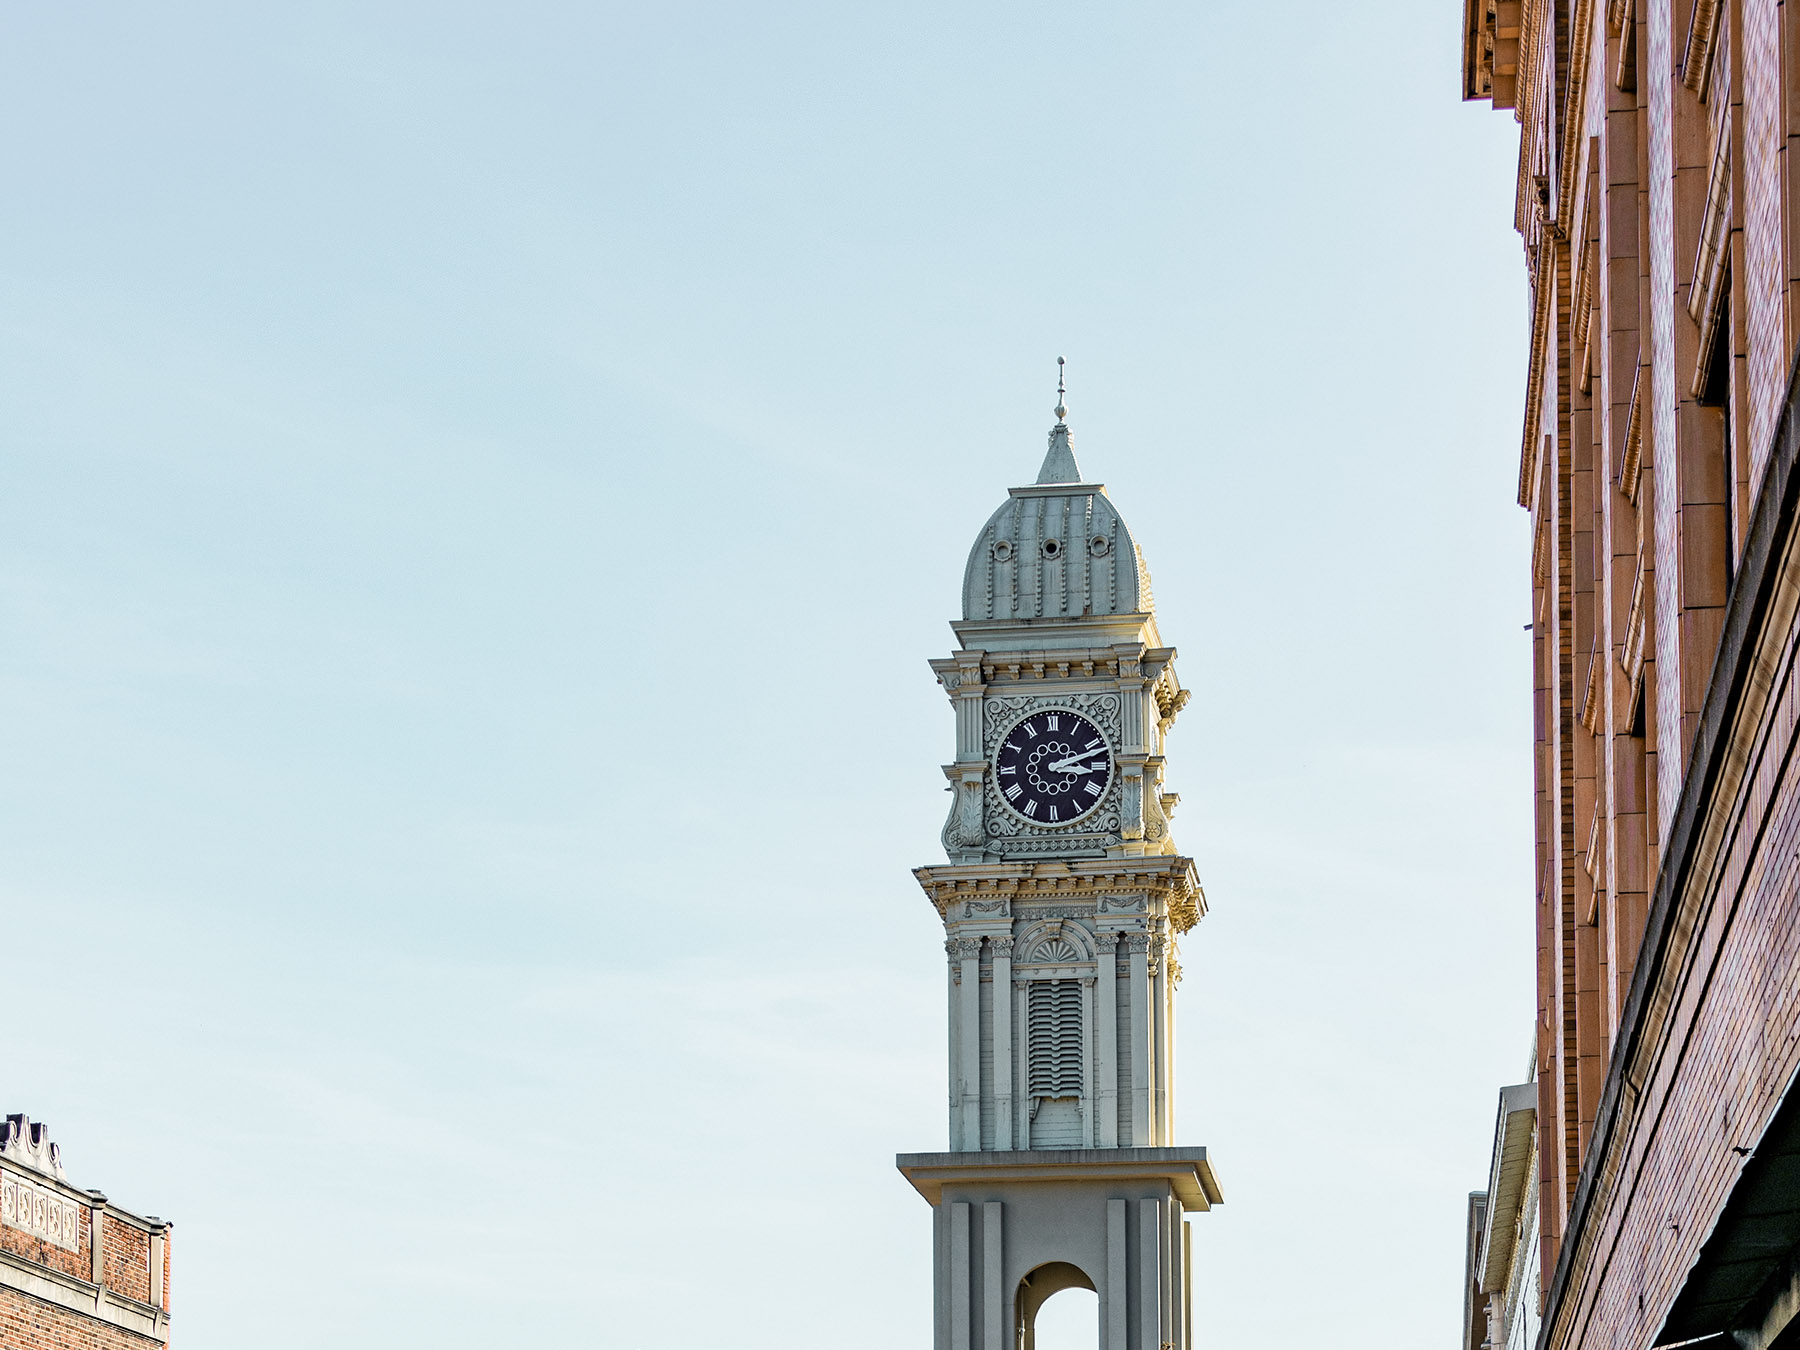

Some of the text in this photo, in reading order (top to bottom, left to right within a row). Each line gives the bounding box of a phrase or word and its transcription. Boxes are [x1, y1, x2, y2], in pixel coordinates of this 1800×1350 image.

[1023, 722, 1038, 739] XI
[1046, 715, 1059, 731] XII
[1070, 720, 1080, 736] I
[1006, 741, 1022, 754] X
[1084, 737, 1100, 750] II
[1000, 765, 1016, 775] IX
[1091, 761, 1107, 771] III
[1005, 782, 1023, 802] VIII
[1023, 799, 1038, 817] VII
[1049, 805, 1059, 820] VI
[1072, 799, 1083, 814] V
